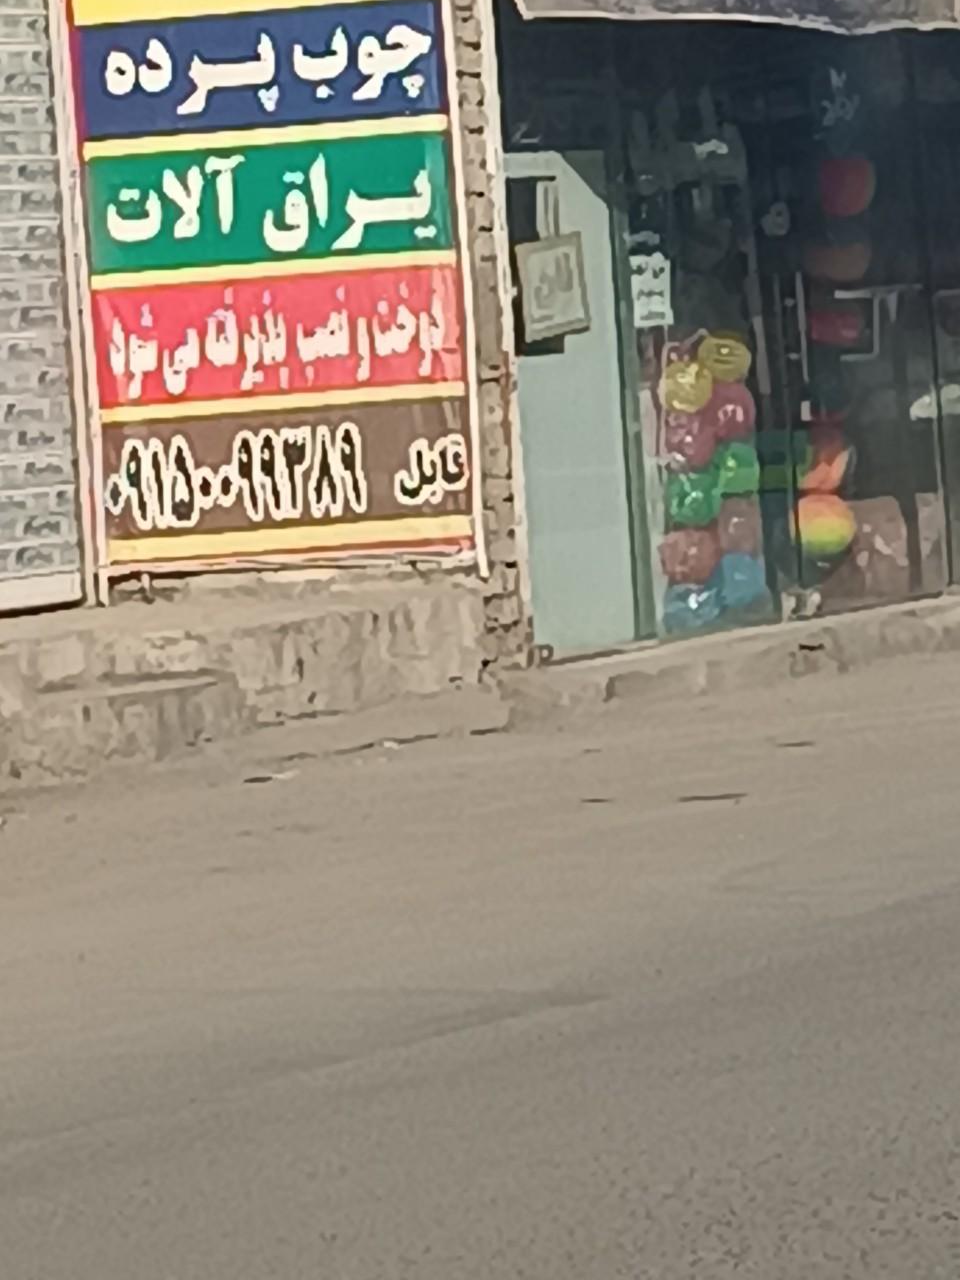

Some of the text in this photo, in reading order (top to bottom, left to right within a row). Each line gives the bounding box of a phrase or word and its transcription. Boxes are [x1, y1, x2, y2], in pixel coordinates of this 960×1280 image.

[104, 24, 433, 115] چوب پرده
[106, 152, 438, 252] یراق آلات
[296, 286, 350, 388] نصب
